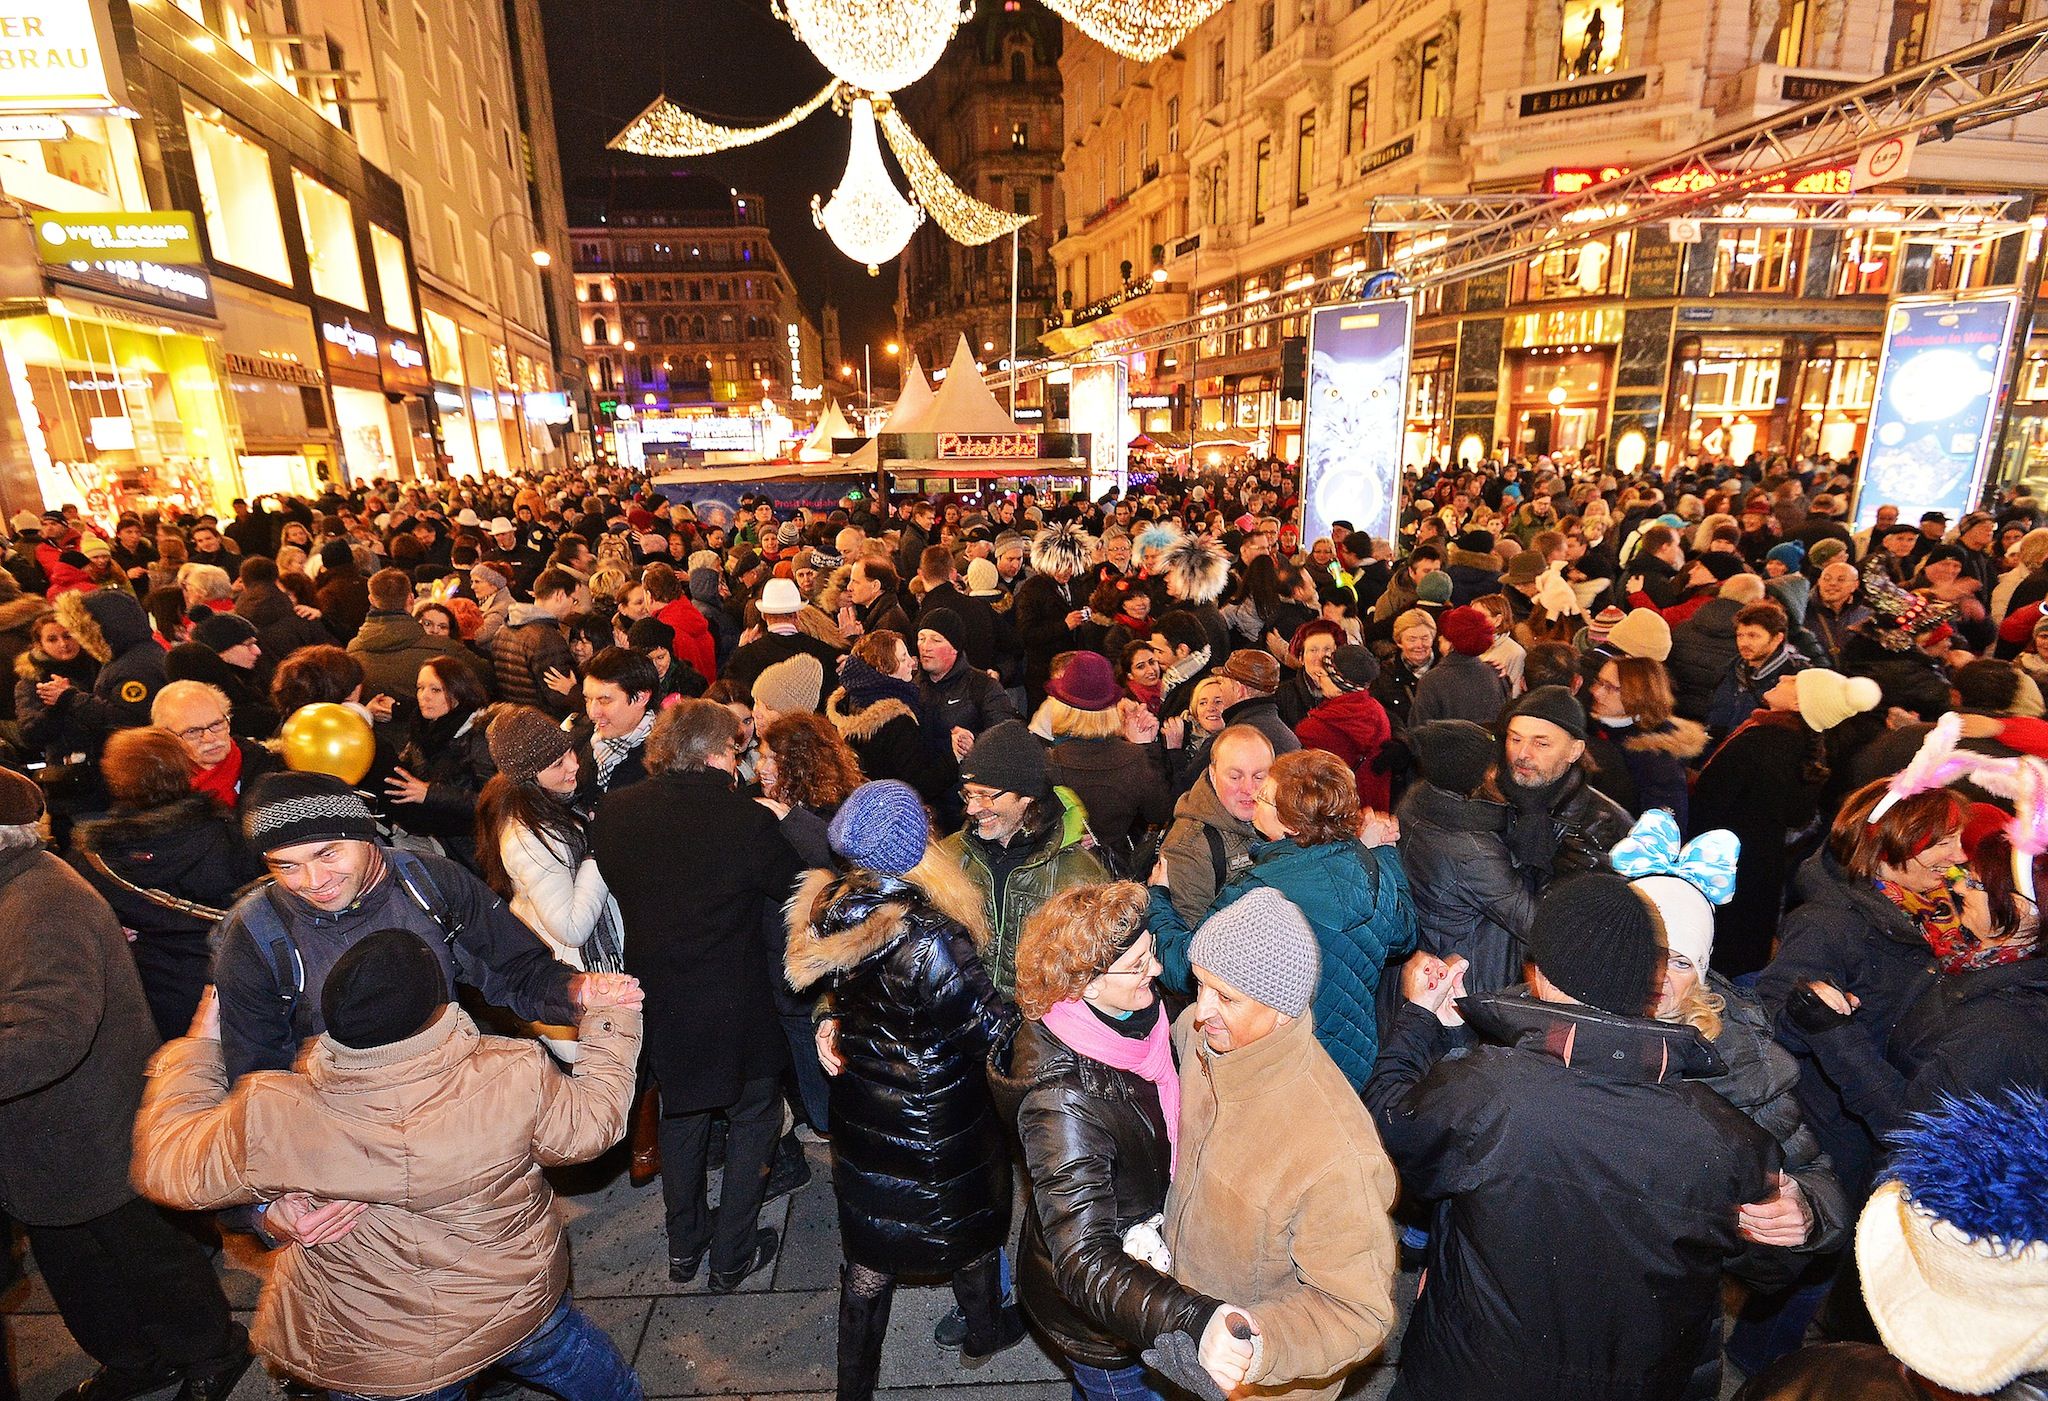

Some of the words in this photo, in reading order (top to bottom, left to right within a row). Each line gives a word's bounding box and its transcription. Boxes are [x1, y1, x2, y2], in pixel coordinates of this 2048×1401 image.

[1551, 88, 1598, 108] BRAUN
[1963, 331, 1999, 344] Wien
[787, 323, 802, 385] HOTEL
